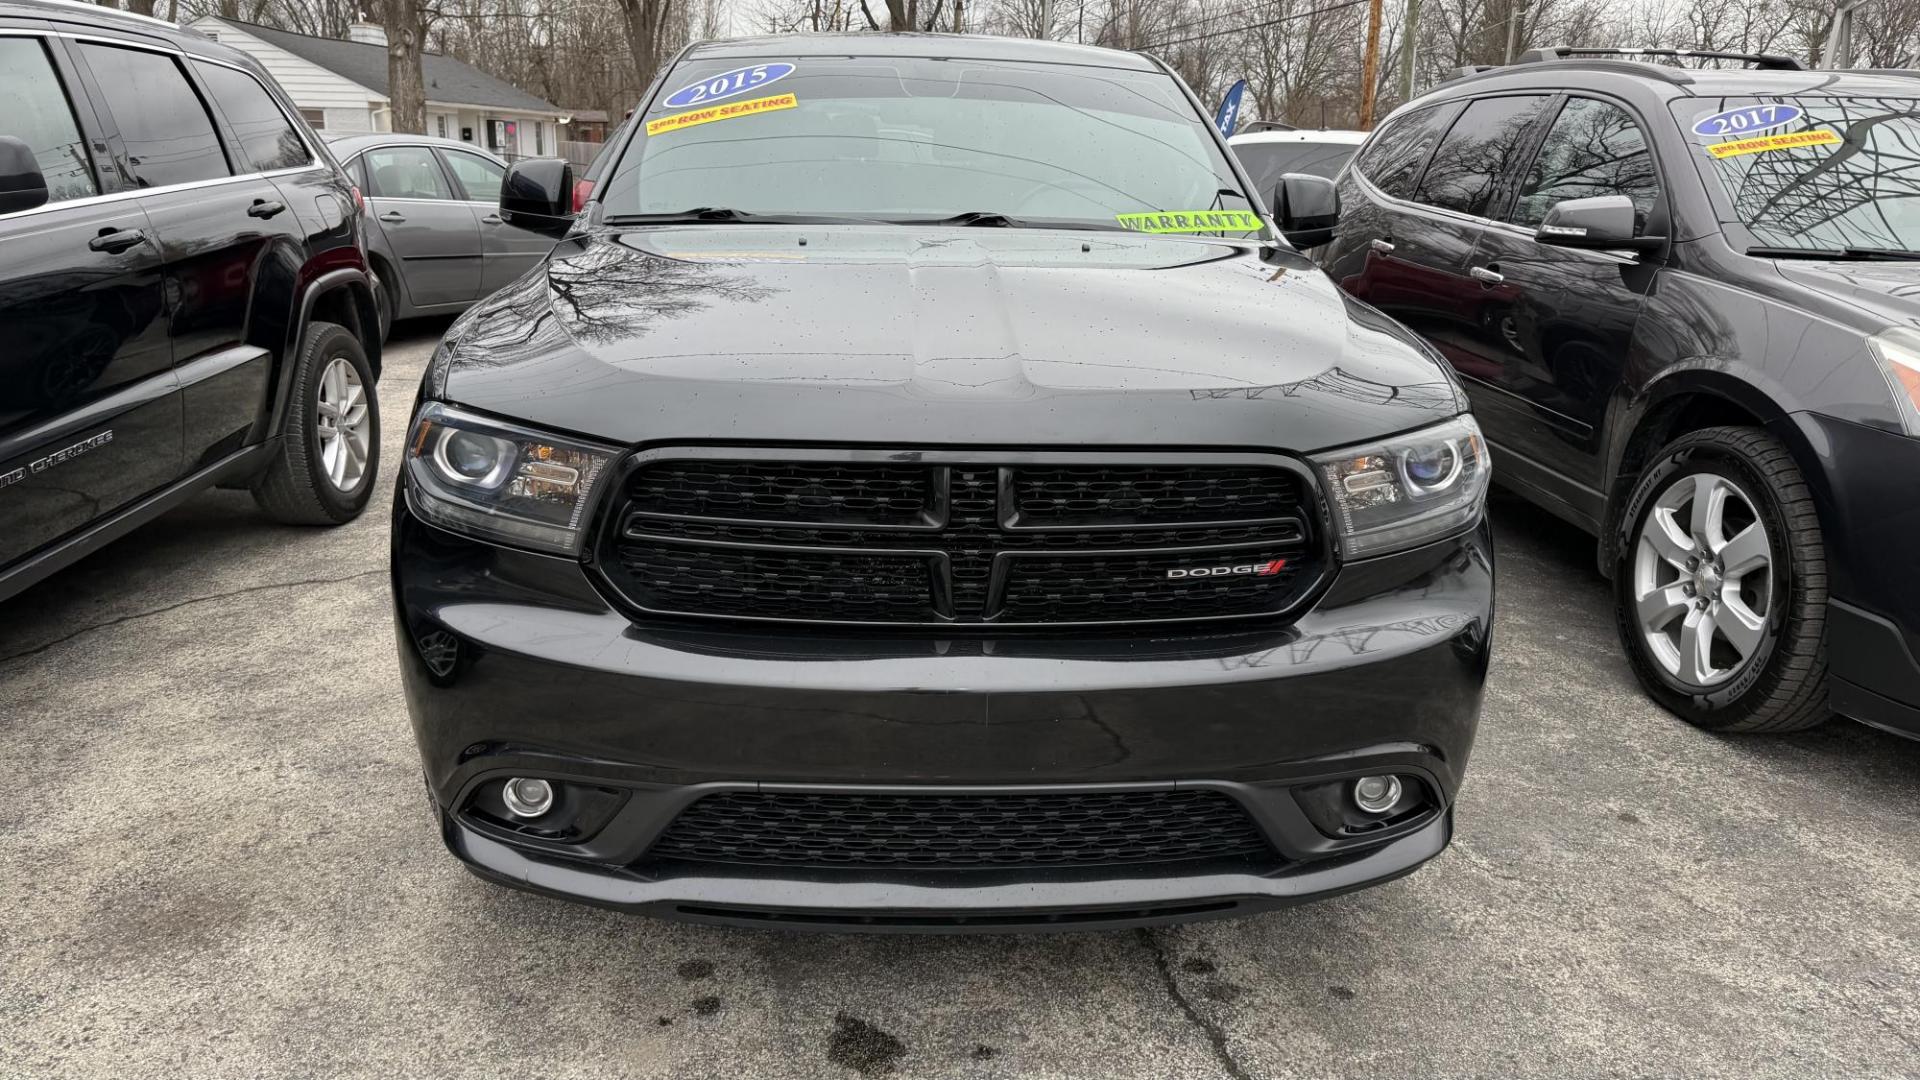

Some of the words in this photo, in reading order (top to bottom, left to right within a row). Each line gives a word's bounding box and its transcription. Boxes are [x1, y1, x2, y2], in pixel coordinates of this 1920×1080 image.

[688, 66, 769, 104] 2015
[677, 110, 718, 125] ROW
[719, 96, 793, 116] SEATING
[1712, 106, 1777, 134] 2017
[1737, 141, 1770, 151] ROW
[1771, 132, 1833, 145] SEATING
[1120, 213, 1252, 231] WARRANTY
[29, 429, 113, 474] CHEROKEE
[1167, 564, 1271, 578] DODGE
